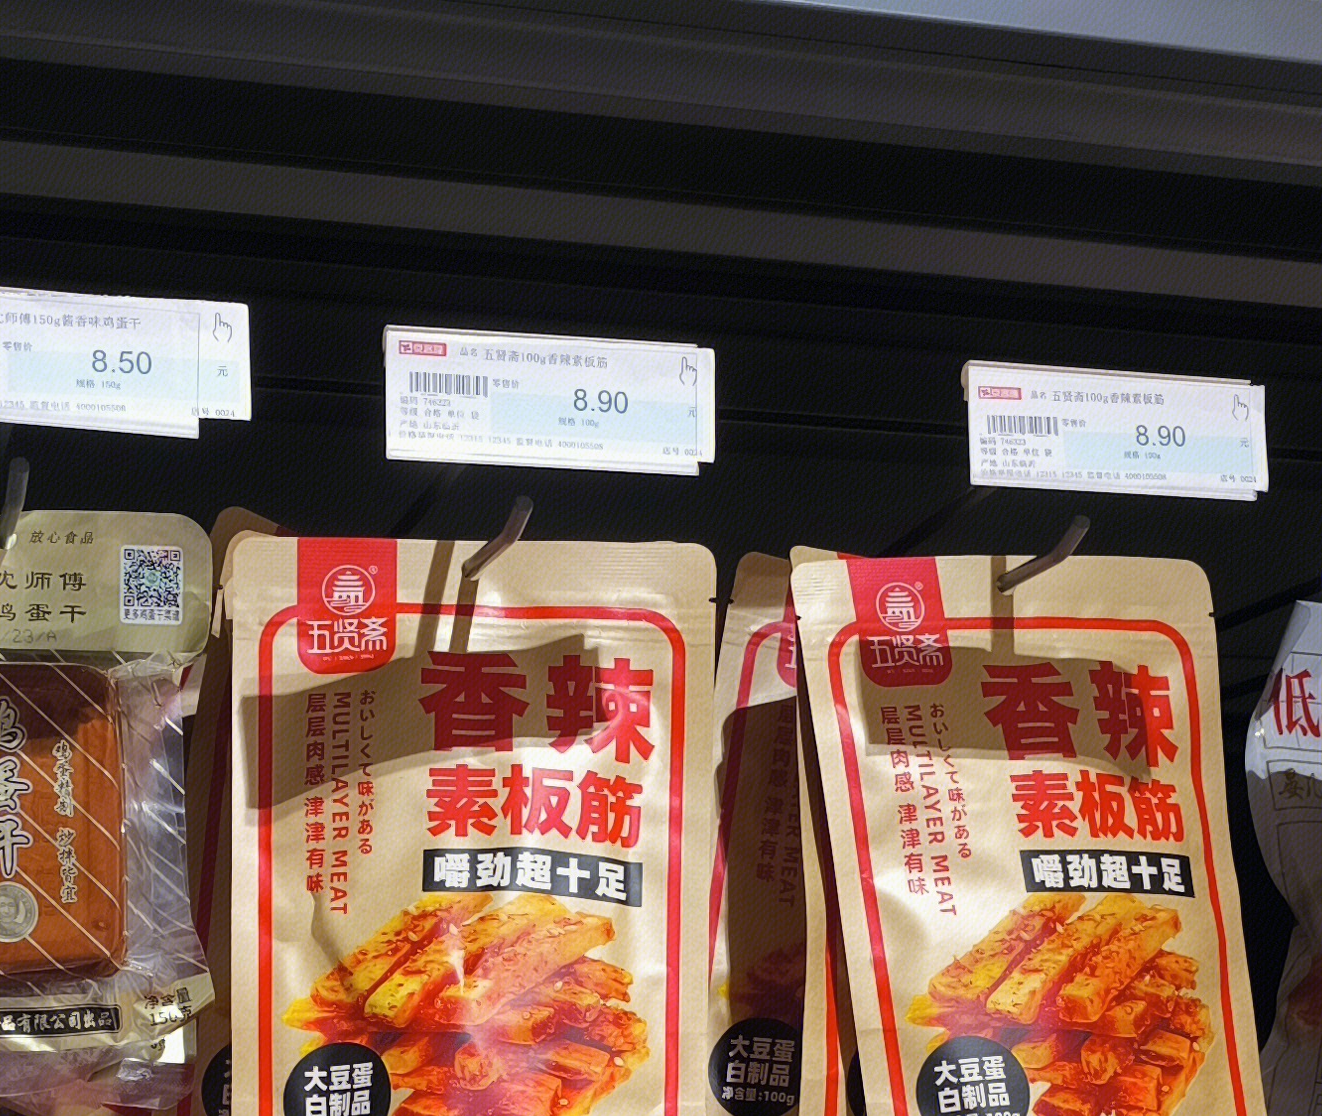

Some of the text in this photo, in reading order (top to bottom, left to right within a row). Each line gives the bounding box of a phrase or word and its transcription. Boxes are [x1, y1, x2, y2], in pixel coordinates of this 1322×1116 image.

[92, 350, 152, 375] 8.50
[574, 388, 628, 414] 8.90
[1136, 424, 1186, 447] 8.90
[29, 530, 94, 545] 放心食品
[305, 616, 388, 653] 五贤斋
[867, 634, 944, 668] 五贤斋
[419, 650, 655, 764] 香辣
[980, 661, 1180, 768] 香辣
[358, 689, 376, 855] おいしくて味がある
[304, 693, 326, 893] 层层肉感 津津有味
[329, 691, 352, 915] MULTILAYER MEAT
[425, 763, 644, 849] 素板筋
[880, 705, 930, 896] 层层肉感 津津有味
[904, 704, 958, 917] MULTILAYER MEAT
[1009, 770, 1186, 842] 素板筋
[433, 851, 629, 901] 嚼劲超十足
[1031, 854, 1187, 892] 嚼劲超十足
[728, 1034, 795, 1061] 大豆蛋
[304, 1062, 374, 1092] 大豆蛋
[727, 1060, 792, 1088] 白制品
[933, 1055, 1006, 1085] 大豆蛋
[937, 1083, 1010, 1113] 白制品
